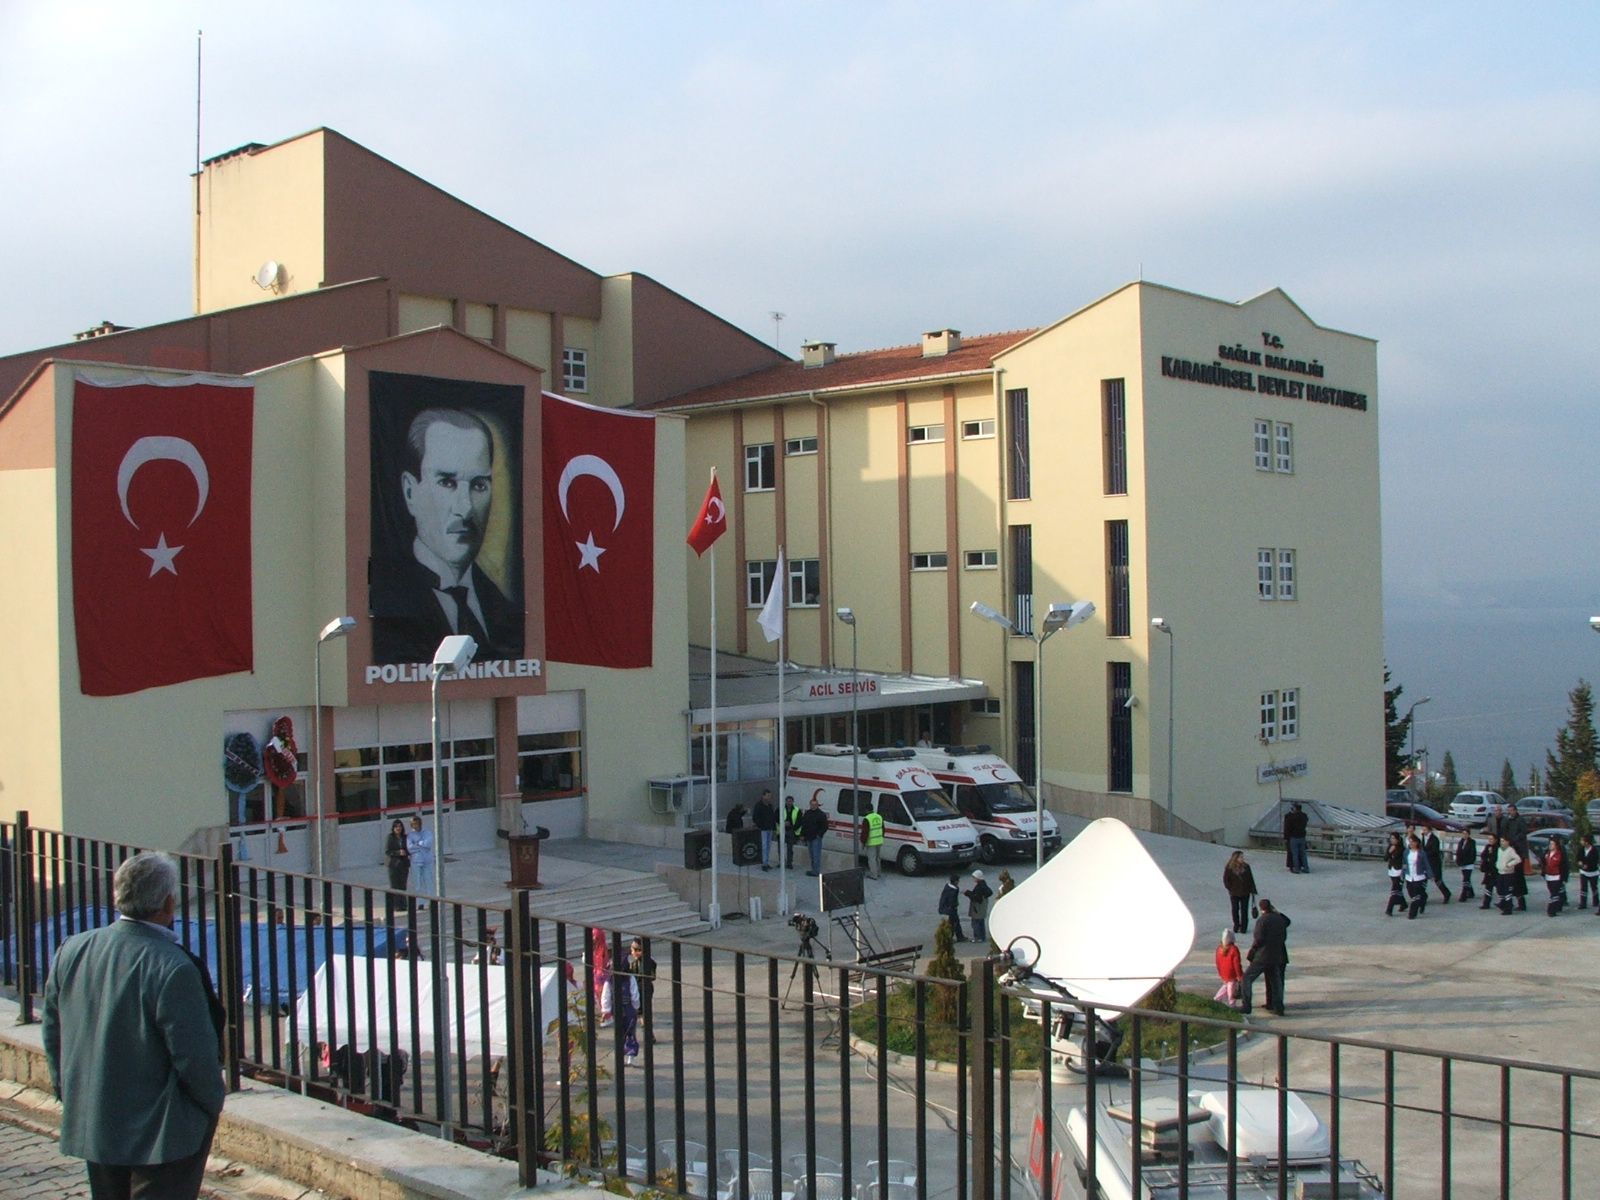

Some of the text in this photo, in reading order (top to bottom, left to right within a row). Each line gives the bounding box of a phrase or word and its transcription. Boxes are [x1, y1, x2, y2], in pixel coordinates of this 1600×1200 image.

[1261, 332, 1284, 349] T.C.
[1218, 344, 1324, 378] SAĞLIK BAKANLIĞI
[1161, 356, 1256, 392] KARAMÜRSEL
[1257, 374, 1305, 399] DEVLET
[838, 678, 877, 695] SERVİS
